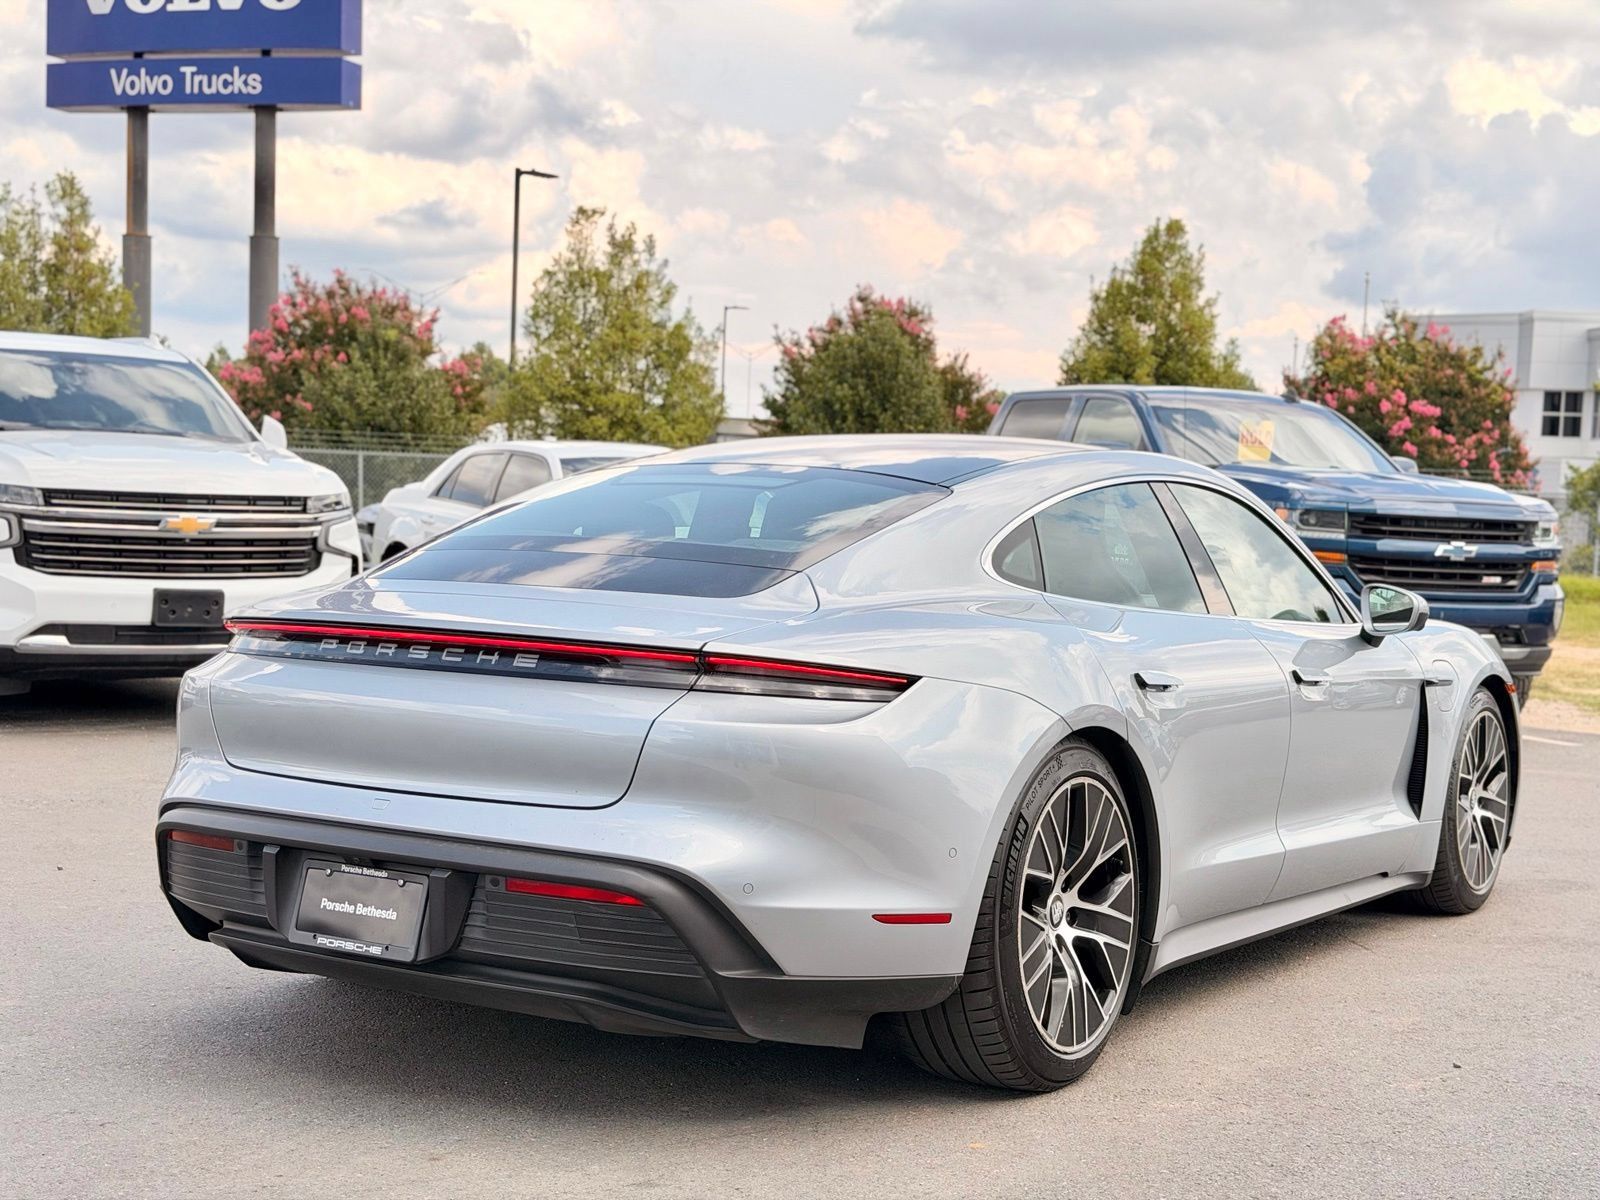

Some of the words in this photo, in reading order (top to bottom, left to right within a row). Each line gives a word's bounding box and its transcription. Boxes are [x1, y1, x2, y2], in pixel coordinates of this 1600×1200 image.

[110, 67, 174, 96] Volvo
[179, 66, 263, 95] Trucks
[319, 639, 540, 668] PORSCHE
[1025, 785, 1039, 811] PILOT
[1037, 767, 1054, 789] SPORT
[341, 864, 362, 875] Porsche
[363, 867, 389, 878] Bethesda
[1002, 816, 1028, 906] MICHELIN
[320, 898, 355, 914] Porsche
[356, 903, 397, 920] Bethesda
[317, 937, 382, 955] PORSCHE
